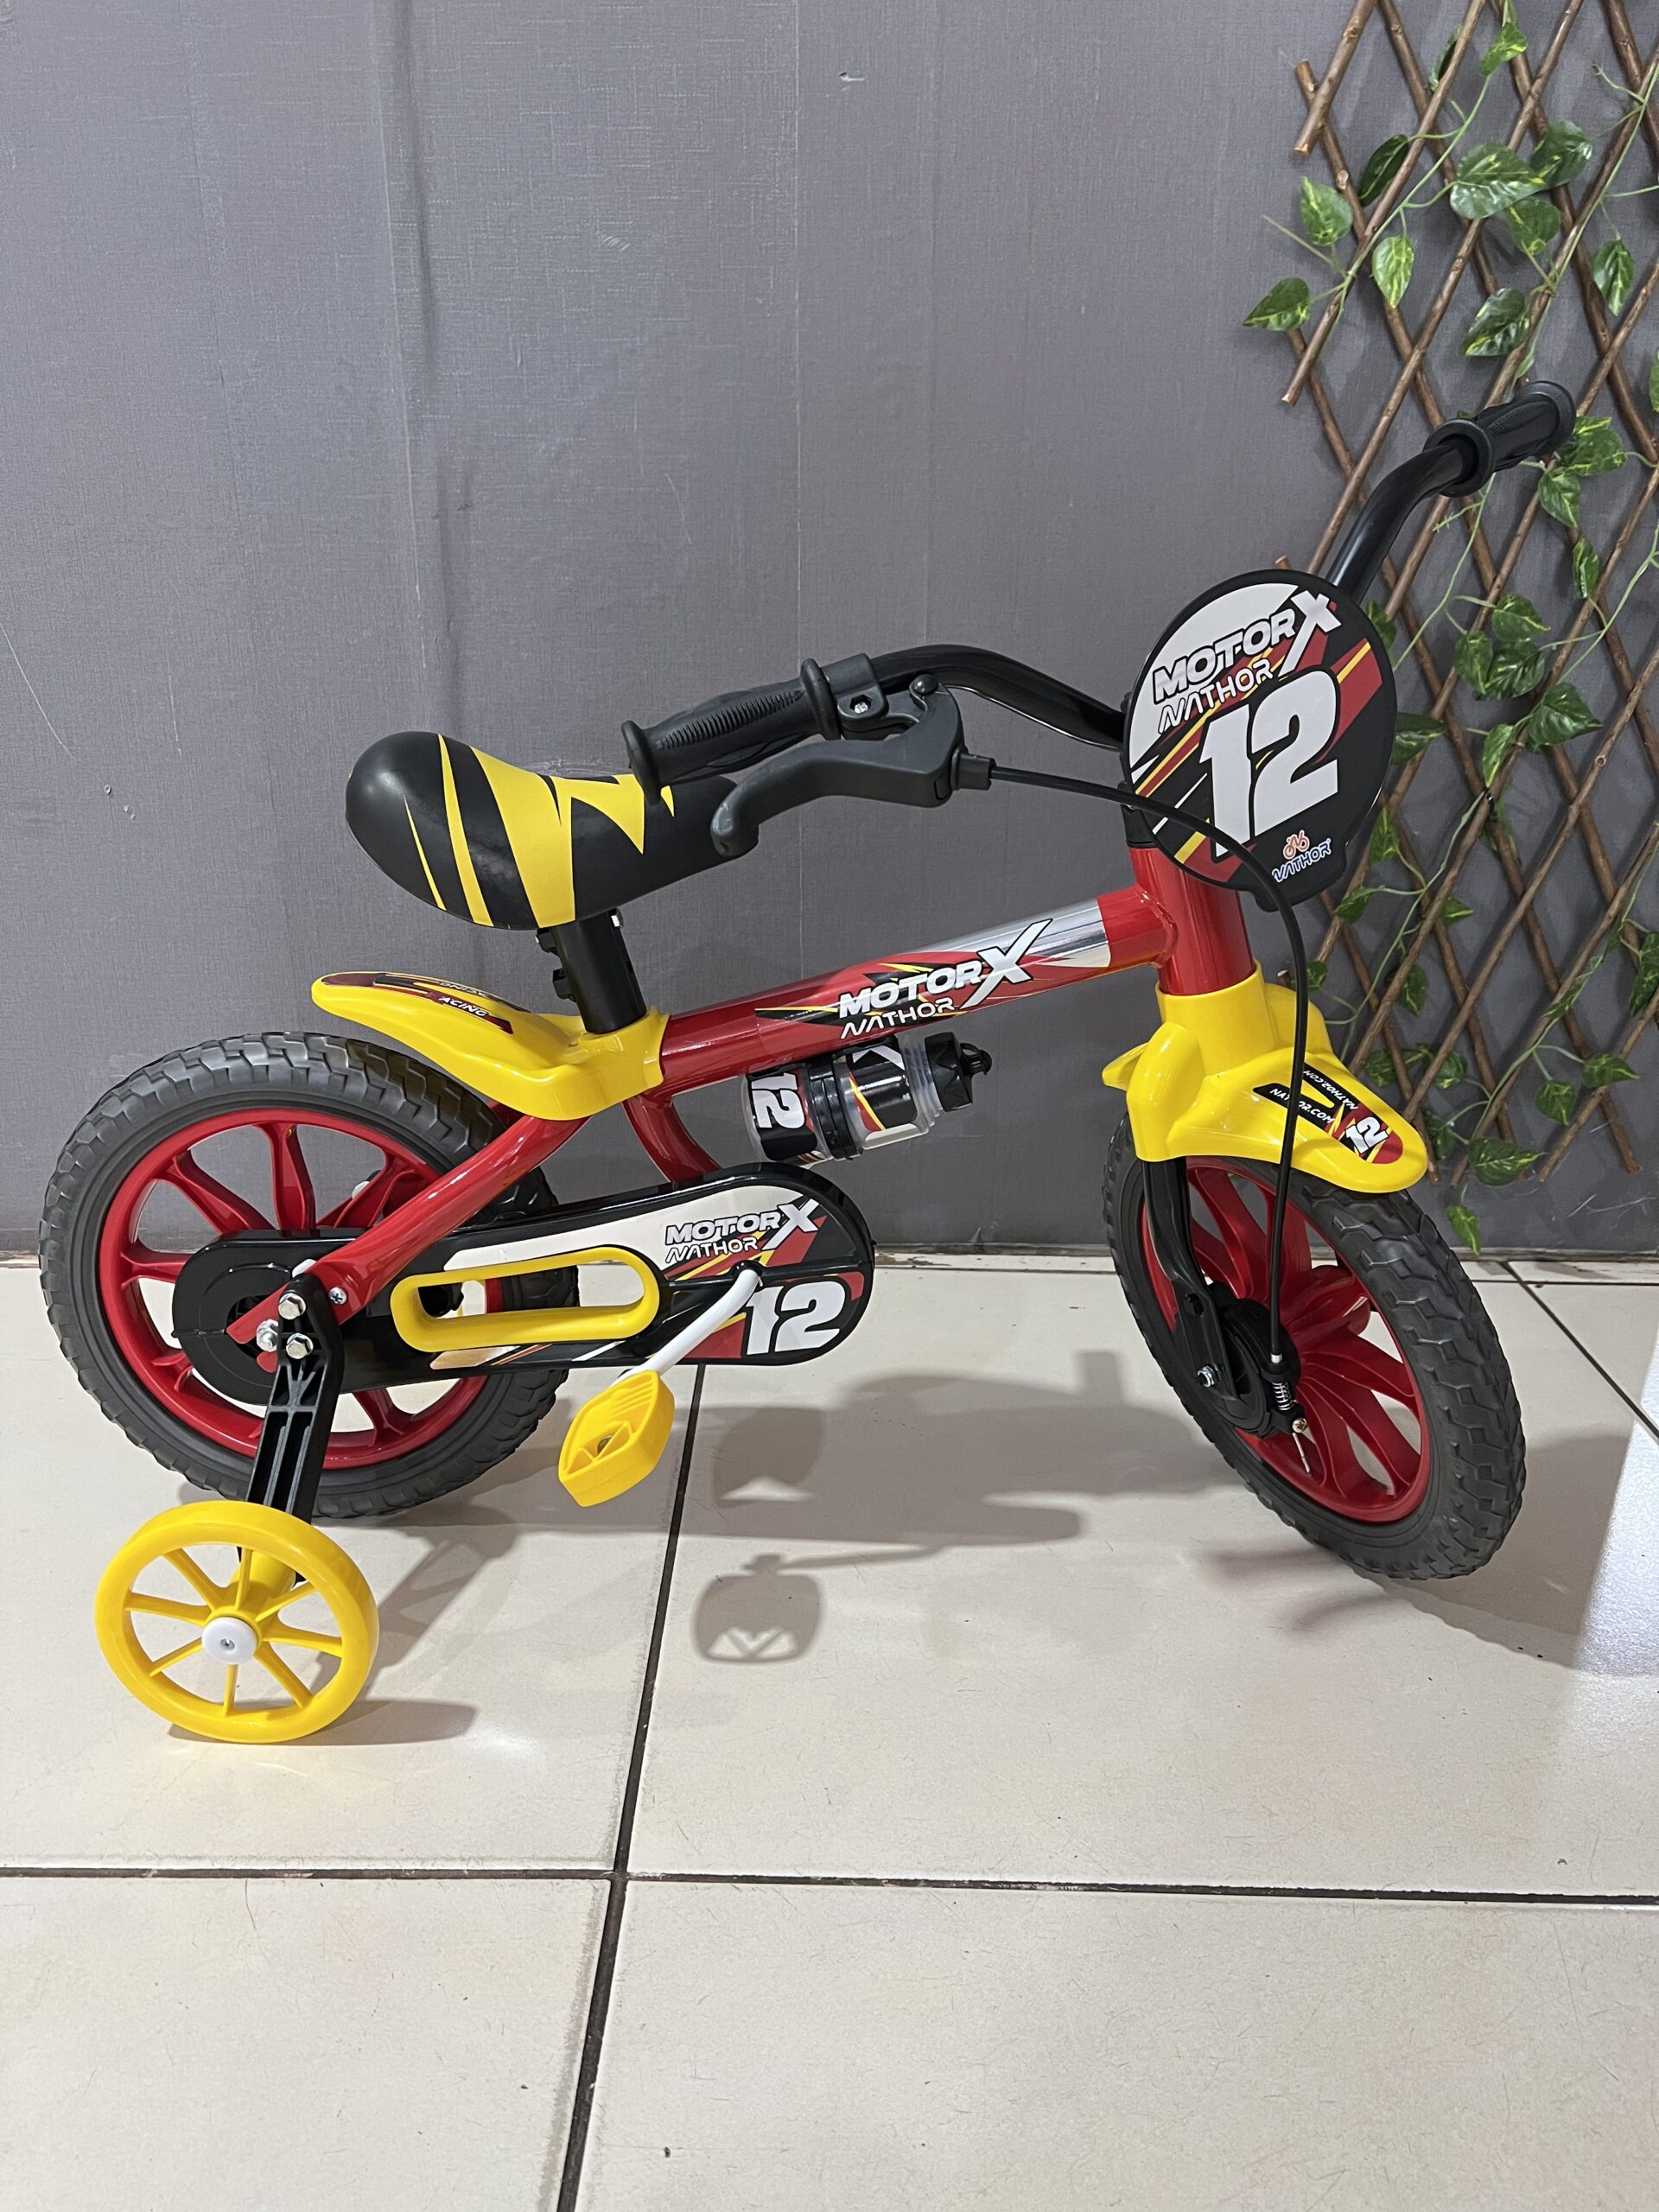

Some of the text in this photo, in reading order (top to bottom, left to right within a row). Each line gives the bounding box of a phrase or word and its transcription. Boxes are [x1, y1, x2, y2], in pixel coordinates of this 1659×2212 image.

[1159, 658, 1274, 733] NATHOR
[1199, 671, 1338, 857] 12
[840, 997, 955, 1039] NATHOR
[752, 1072, 805, 1128] 12
[1345, 1116, 1389, 1154] 12
[665, 1236, 759, 1264] NATHOR
[747, 1281, 846, 1355] 12
